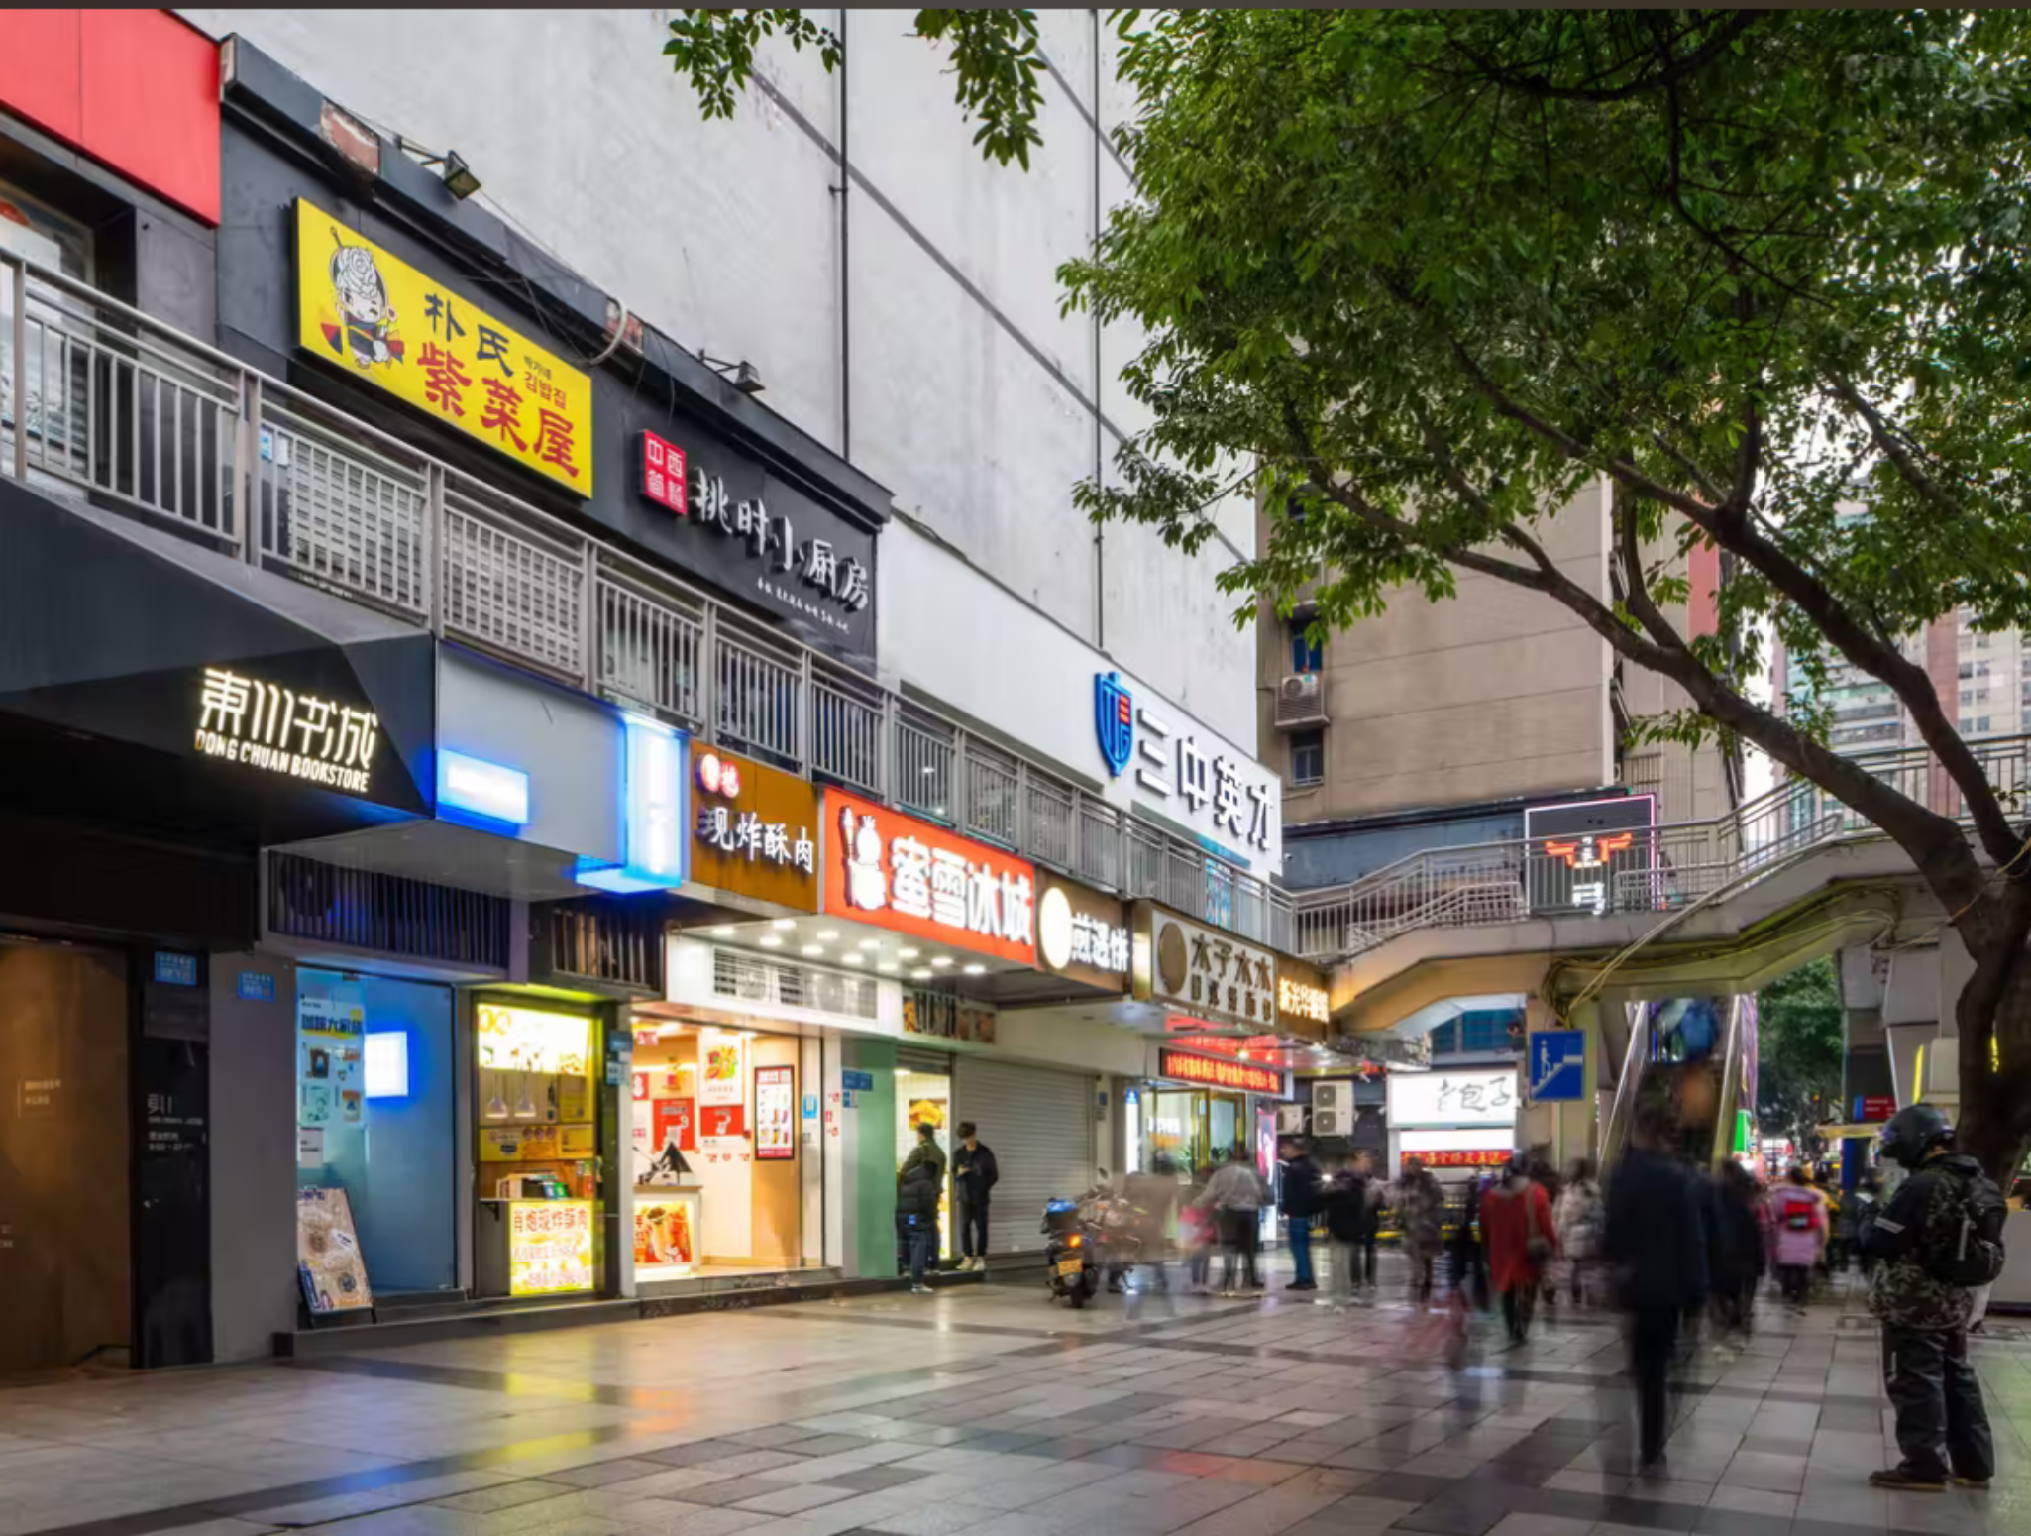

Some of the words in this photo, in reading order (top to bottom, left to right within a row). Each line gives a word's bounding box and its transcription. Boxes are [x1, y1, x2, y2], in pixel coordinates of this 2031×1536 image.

[417, 341, 579, 478] 紫菜屋
[195, 728, 239, 761] DONG
[240, 741, 290, 774] CHUAN
[290, 755, 370, 792] BOOKSTORE
[1138, 709, 1271, 850] 三中英才
[700, 806, 813, 874] 现炸酥肉
[890, 834, 1033, 947] 蜜雪冰城
